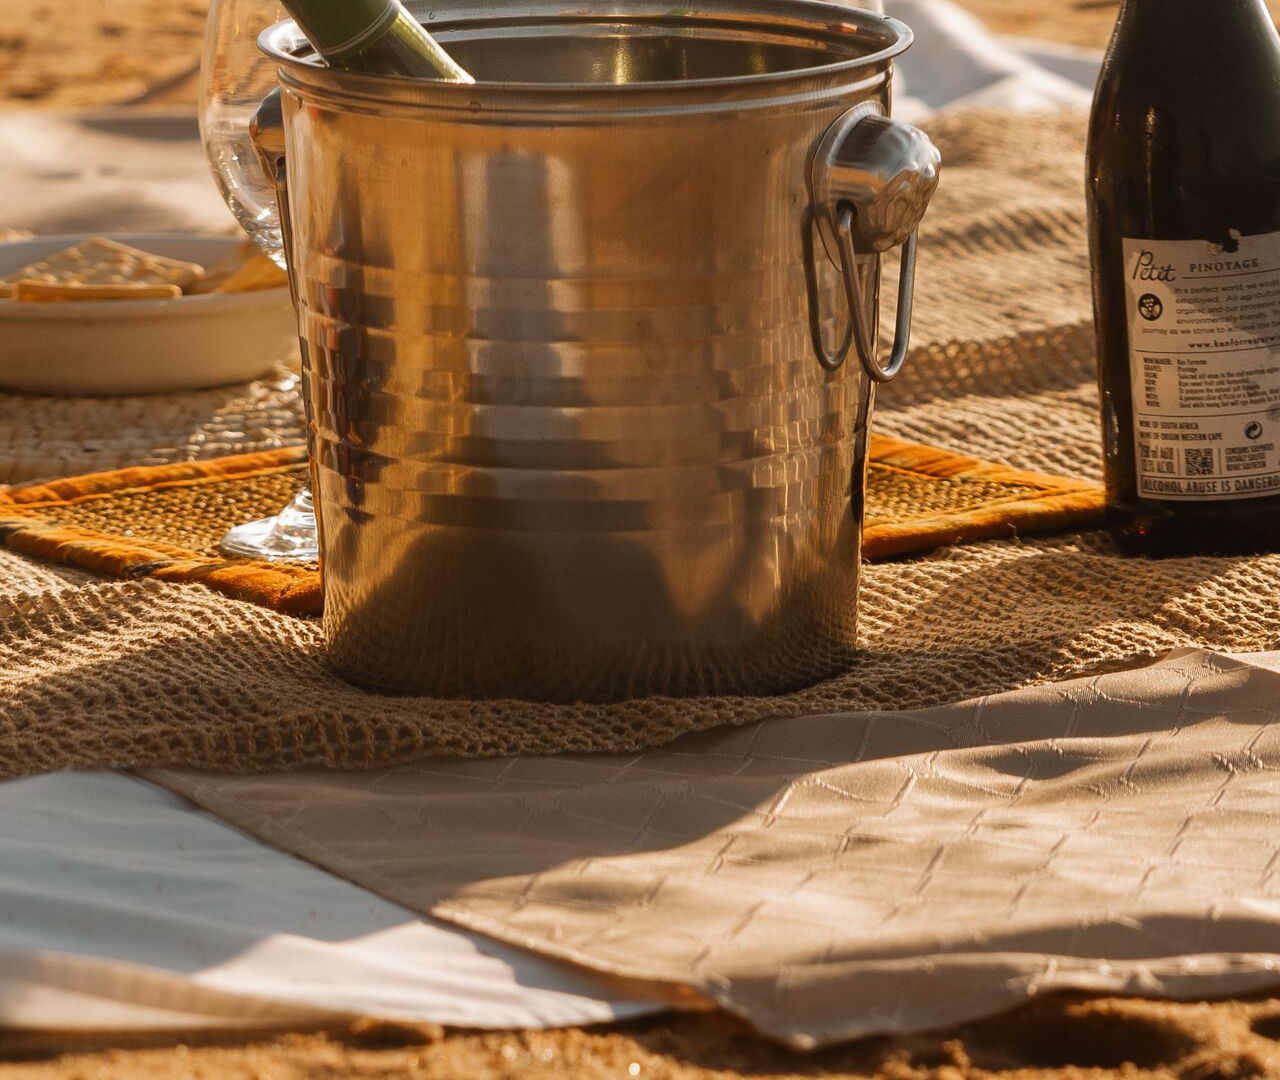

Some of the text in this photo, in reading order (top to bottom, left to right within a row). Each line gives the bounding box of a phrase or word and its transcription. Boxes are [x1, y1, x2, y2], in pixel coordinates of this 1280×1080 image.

[1132, 249, 1259, 281] Petit PINOTAGE
[1190, 286, 1219, 295] perfect
[1193, 327, 1215, 335] strive
[1142, 479, 1183, 493] ALCOHOL
[1185, 480, 1218, 493] ABUSE
[1221, 480, 1231, 492] IS
